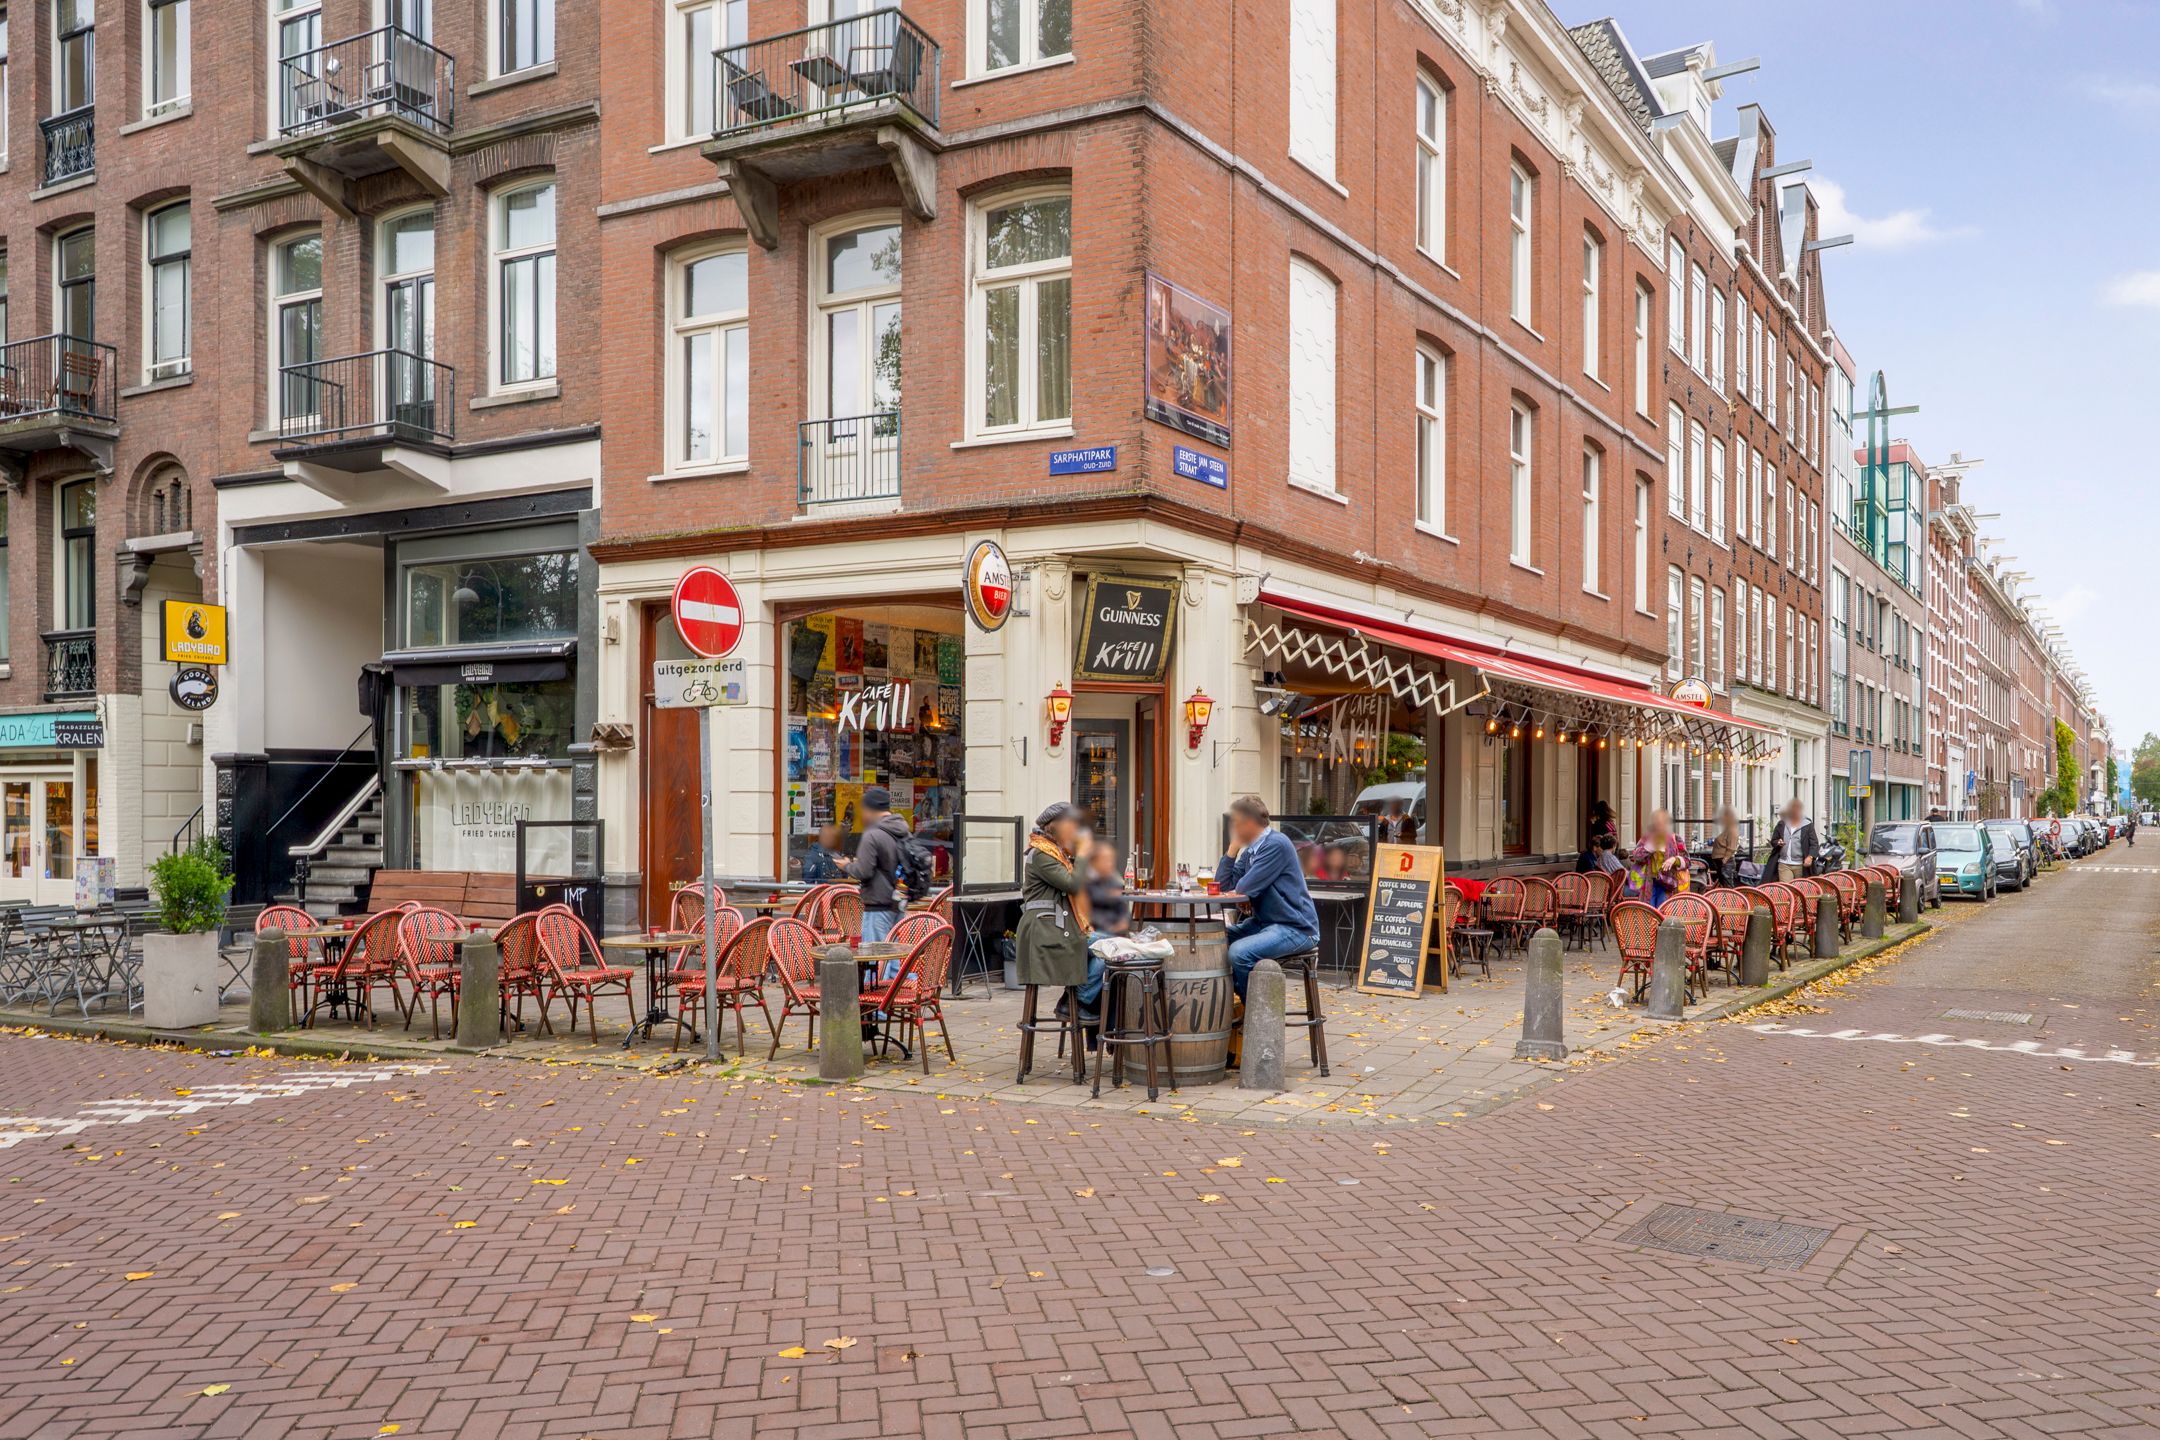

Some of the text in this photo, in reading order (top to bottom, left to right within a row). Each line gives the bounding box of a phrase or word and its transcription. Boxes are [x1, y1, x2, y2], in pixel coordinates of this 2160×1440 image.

[1053, 449, 1111, 464] SARPHATIPARK
[1179, 449, 1224, 473] EERSTE JAN STEEN
[1083, 461, 1111, 470] OUD-ZUID
[1179, 462, 1197, 475] STRAAT
[994, 590, 1007, 601] BIER
[1100, 606, 1161, 627] GUINNESS
[171, 641, 221, 656] LADYBIRD
[1092, 642, 1154, 671] Krull
[461, 663, 493, 677] LADYBIRD
[658, 661, 742, 678] uitgezonderd
[184, 671, 211, 682] GOOSE
[862, 683, 893, 700] CAFÉ
[183, 696, 212, 707] ISLAND
[940, 696, 960, 704] NIGHT
[1350, 692, 1377, 716] CAFÉ
[838, 683, 910, 734] Krull
[941, 704, 960, 715] LIVE
[55, 732, 103, 745] KRALEN
[1328, 695, 1391, 771] Krull
[451, 801, 533, 826] LADYBIRD
[462, 829, 517, 838] FRIED CHICKE
[1378, 880, 1399, 889] COFFEE
[1384, 915, 1407, 924] COFFEE
[1380, 924, 1411, 936] LUNCH
